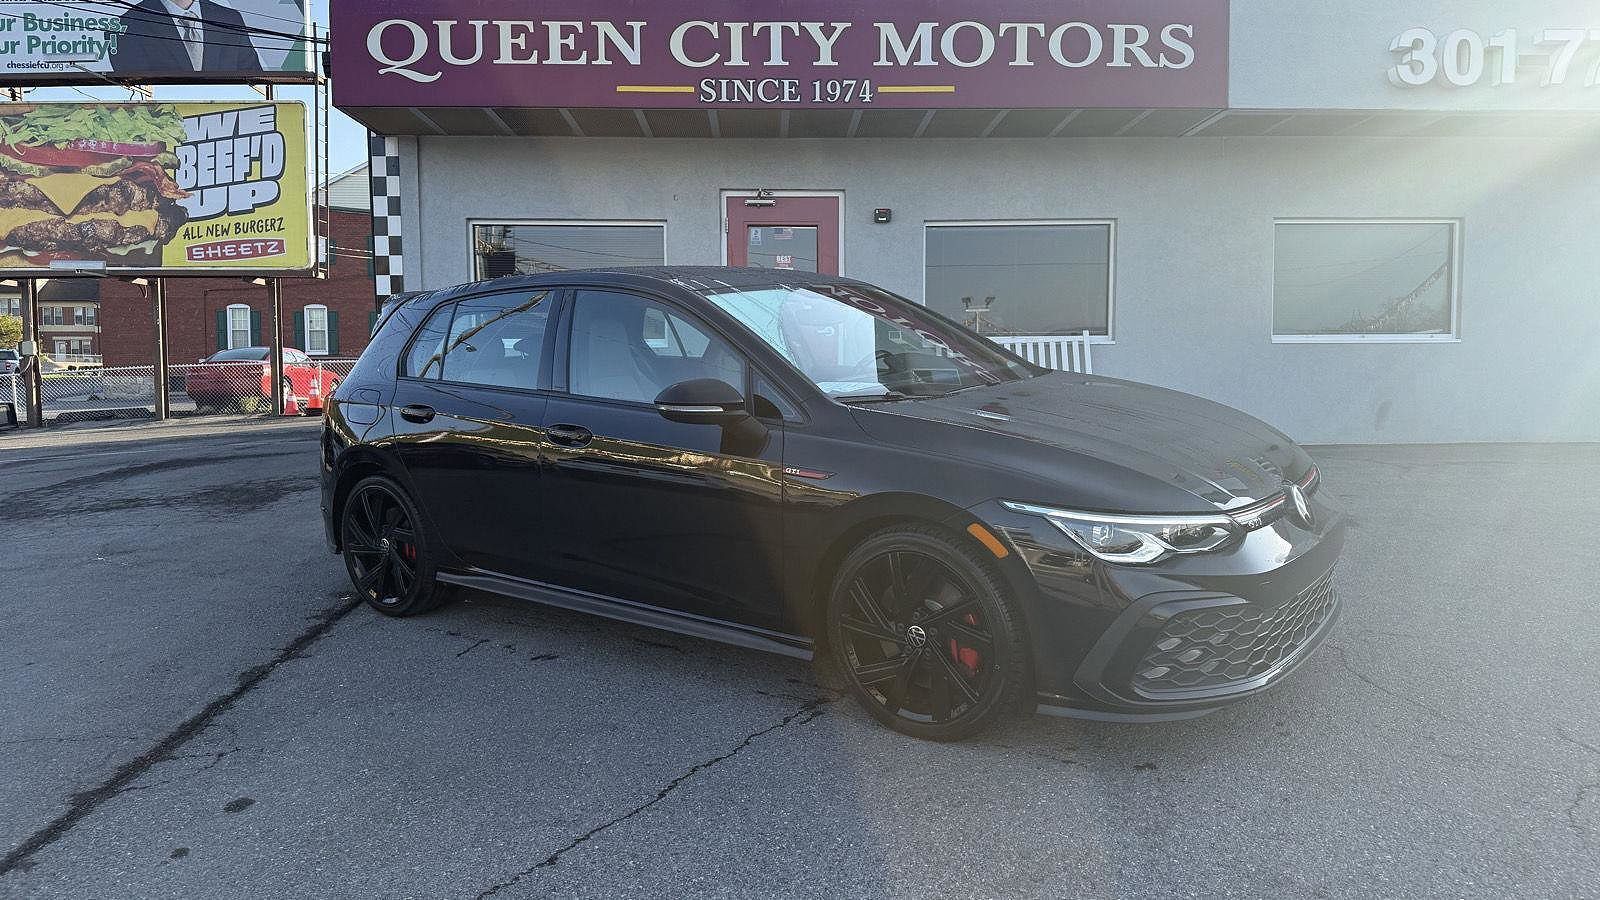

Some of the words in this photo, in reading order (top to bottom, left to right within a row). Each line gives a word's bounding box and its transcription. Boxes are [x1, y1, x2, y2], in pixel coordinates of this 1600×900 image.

[23, 12, 128, 35] Business,
[27, 34, 117, 60] Priority!
[366, 19, 647, 83] QUEEN
[669, 20, 852, 67] CITY
[873, 21, 1195, 69] MOTORS
[7, 61, 64, 71] chessiefcu.org
[700, 78, 801, 103] SINCE
[812, 79, 873, 103] 1974
[183, 105, 277, 143] WE
[175, 131, 286, 190] BEEF'D
[178, 180, 280, 222] UP
[183, 225, 203, 240] ALL
[206, 222, 231, 238] NEW
[234, 217, 285, 235] BURGERZ
[192, 241, 280, 260] SHEETZ
